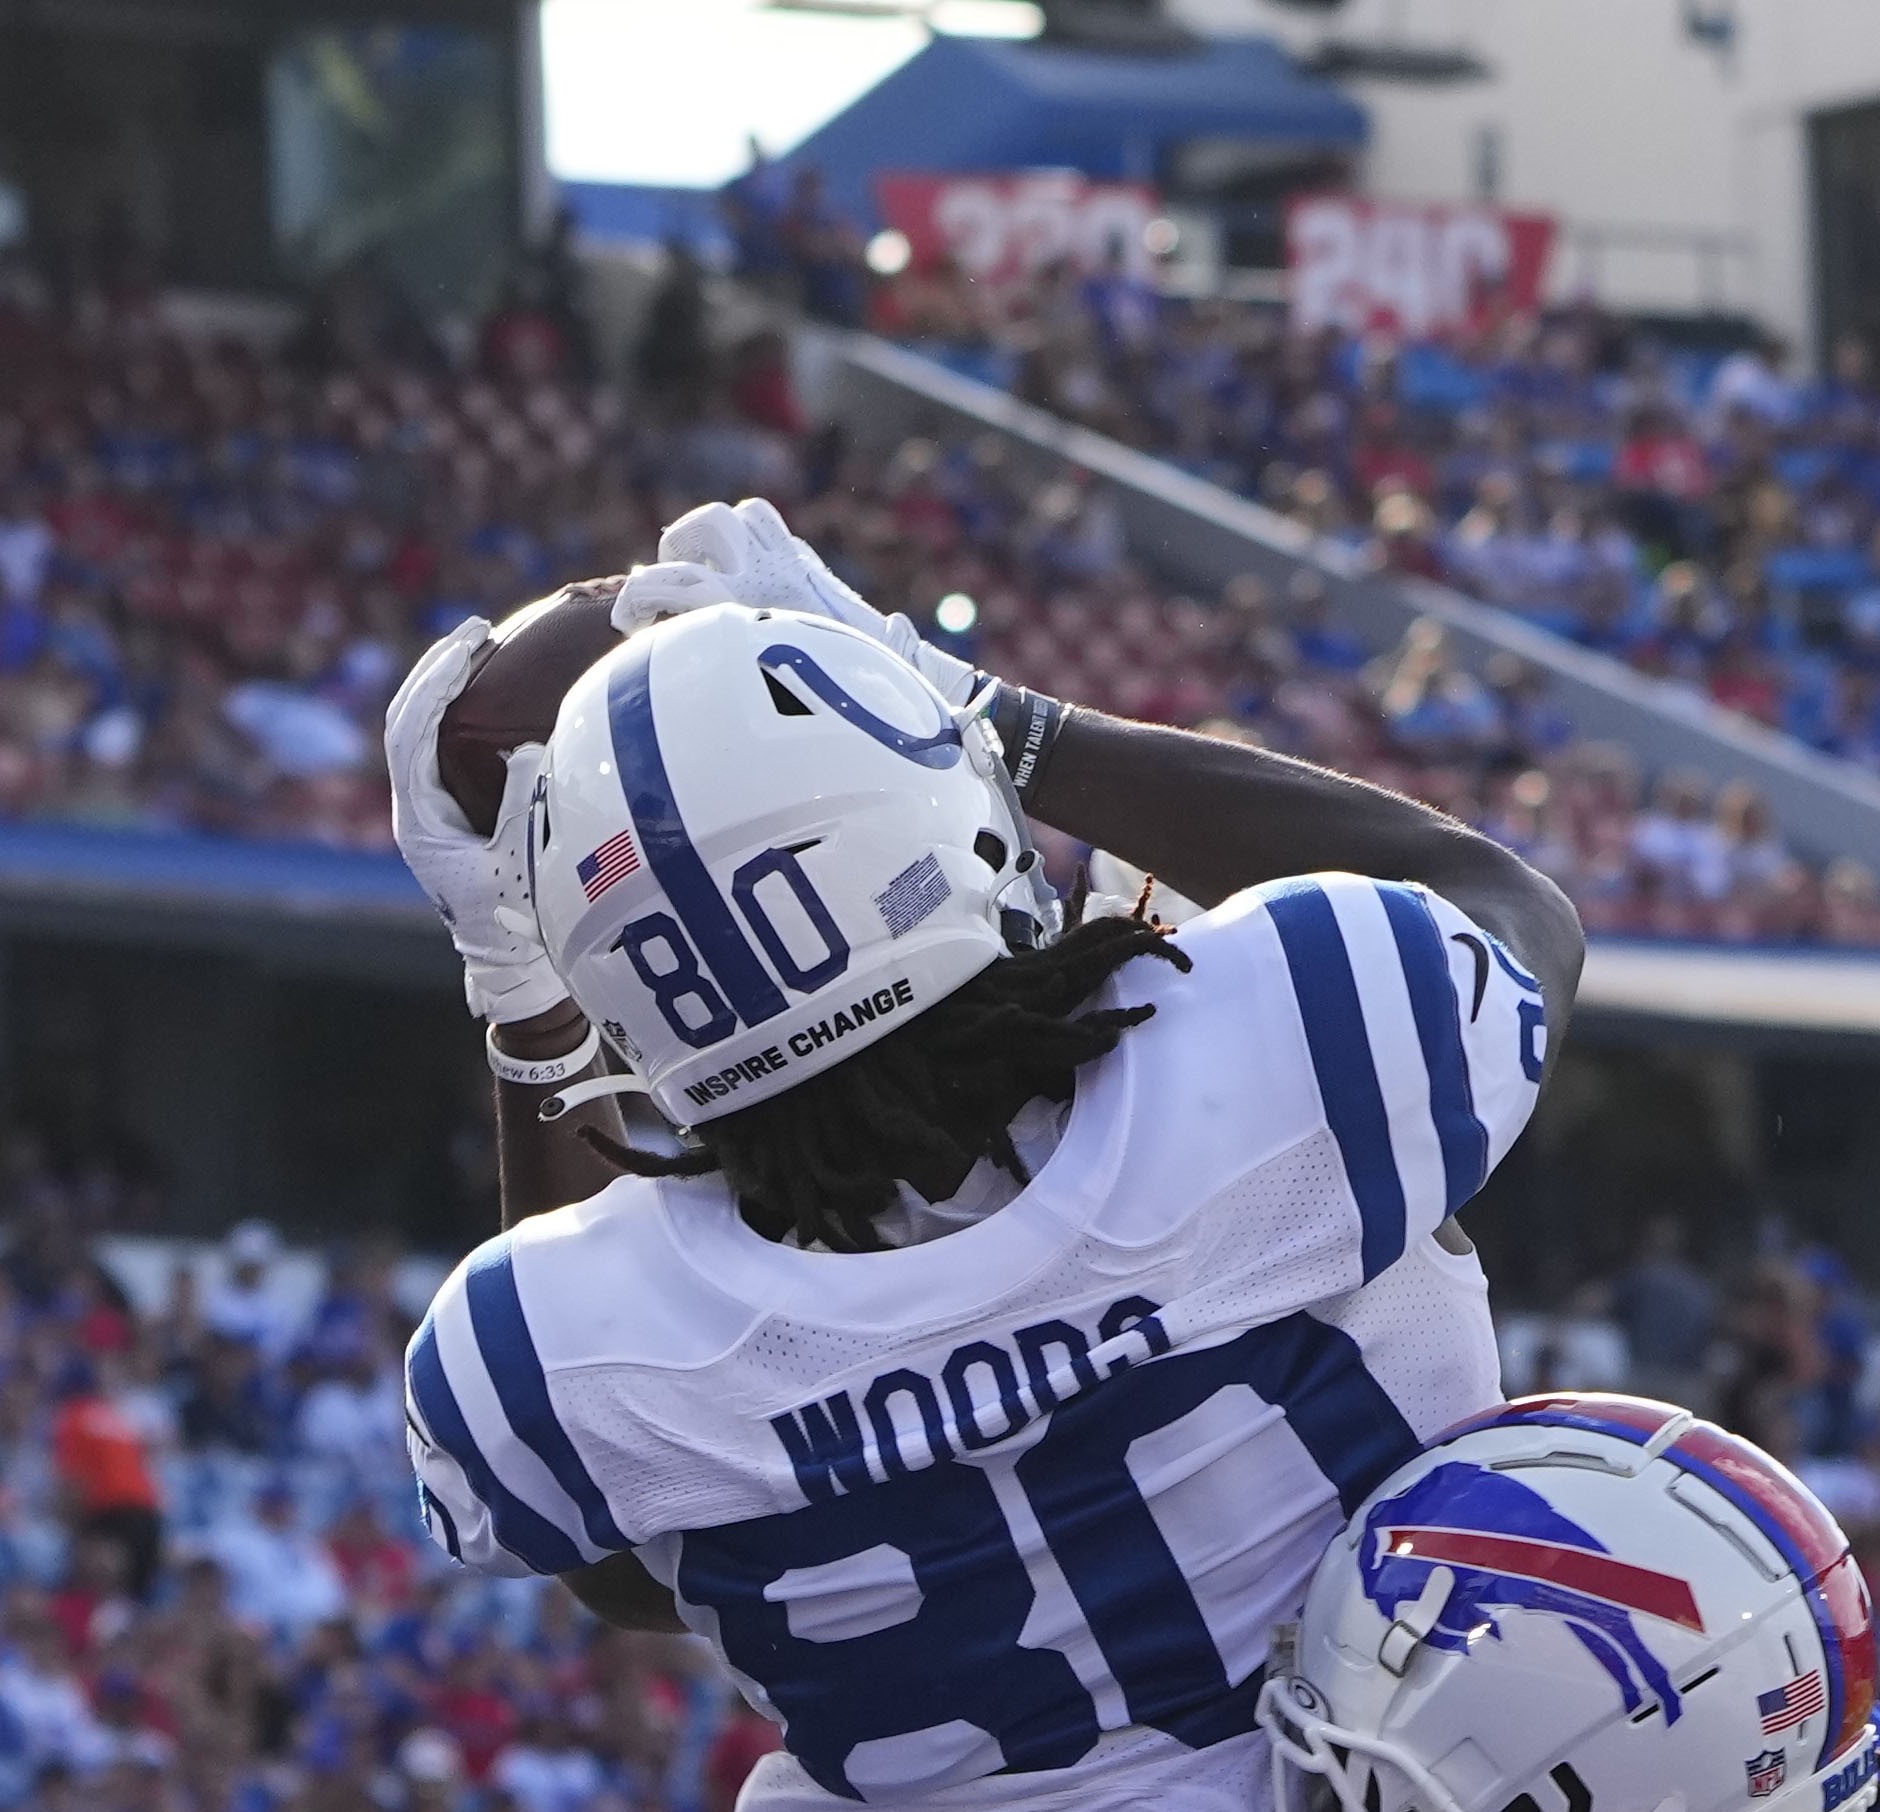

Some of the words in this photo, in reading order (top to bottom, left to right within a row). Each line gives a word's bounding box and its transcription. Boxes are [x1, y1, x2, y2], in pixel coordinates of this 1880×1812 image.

[1013, 752, 1038, 788] WHEN
[623, 846, 851, 1050] 80
[528, 1062, 566, 1081] 6:33
[683, 1045, 789, 1106] INSPIRE
[787, 978, 915, 1057] CHANGE
[678, 1309, 1422, 1803] 80
